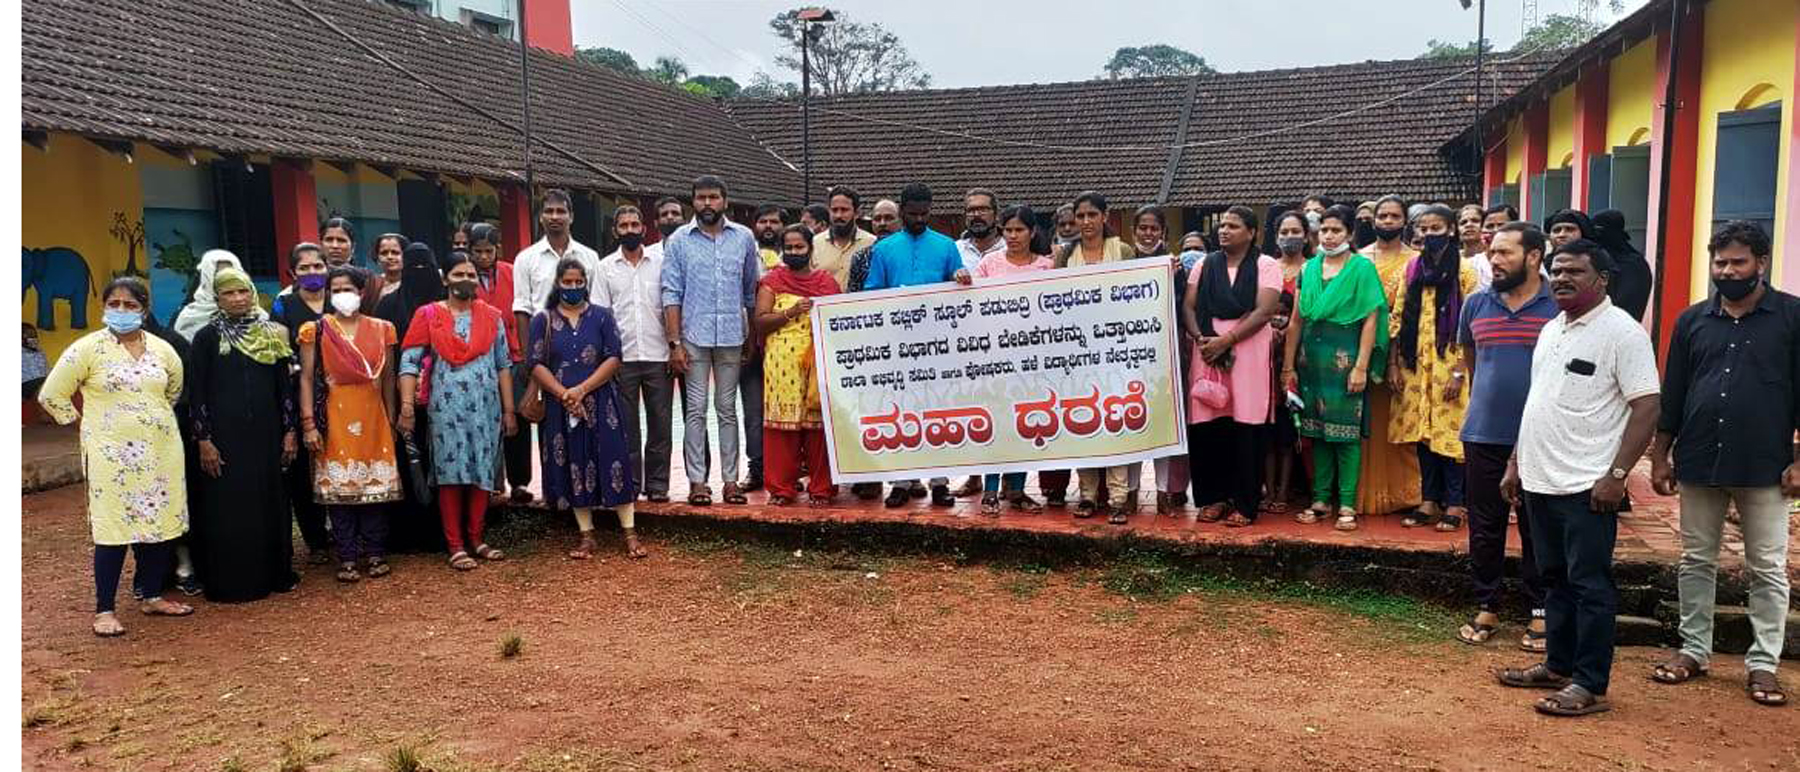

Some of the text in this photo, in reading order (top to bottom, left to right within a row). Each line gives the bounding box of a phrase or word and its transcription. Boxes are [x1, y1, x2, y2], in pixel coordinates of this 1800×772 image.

[829, 279, 1160, 331] ಕರ್ನಾಟಕ ಪಬ್ಲಿಕ್ ಸ್ಕೂಲ್ ಪಡುಬಿದ್ರಿ (ಪ್ರಾಥಮಿಕ ವಿಭಾಗ)
[835, 316, 1162, 369] ಪ್ರಾಥಮಿಕ ವಿಭಾಗದ ವಿವಿಧ ಬೇಡಿಕೆಗಳನ್ನು ಒತ್ತಾಯಿಸಿ
[908, 367, 936, 382] ಸಮಿತಿ
[860, 380, 1148, 452] ಮಹಾ ಧರಣಿ
